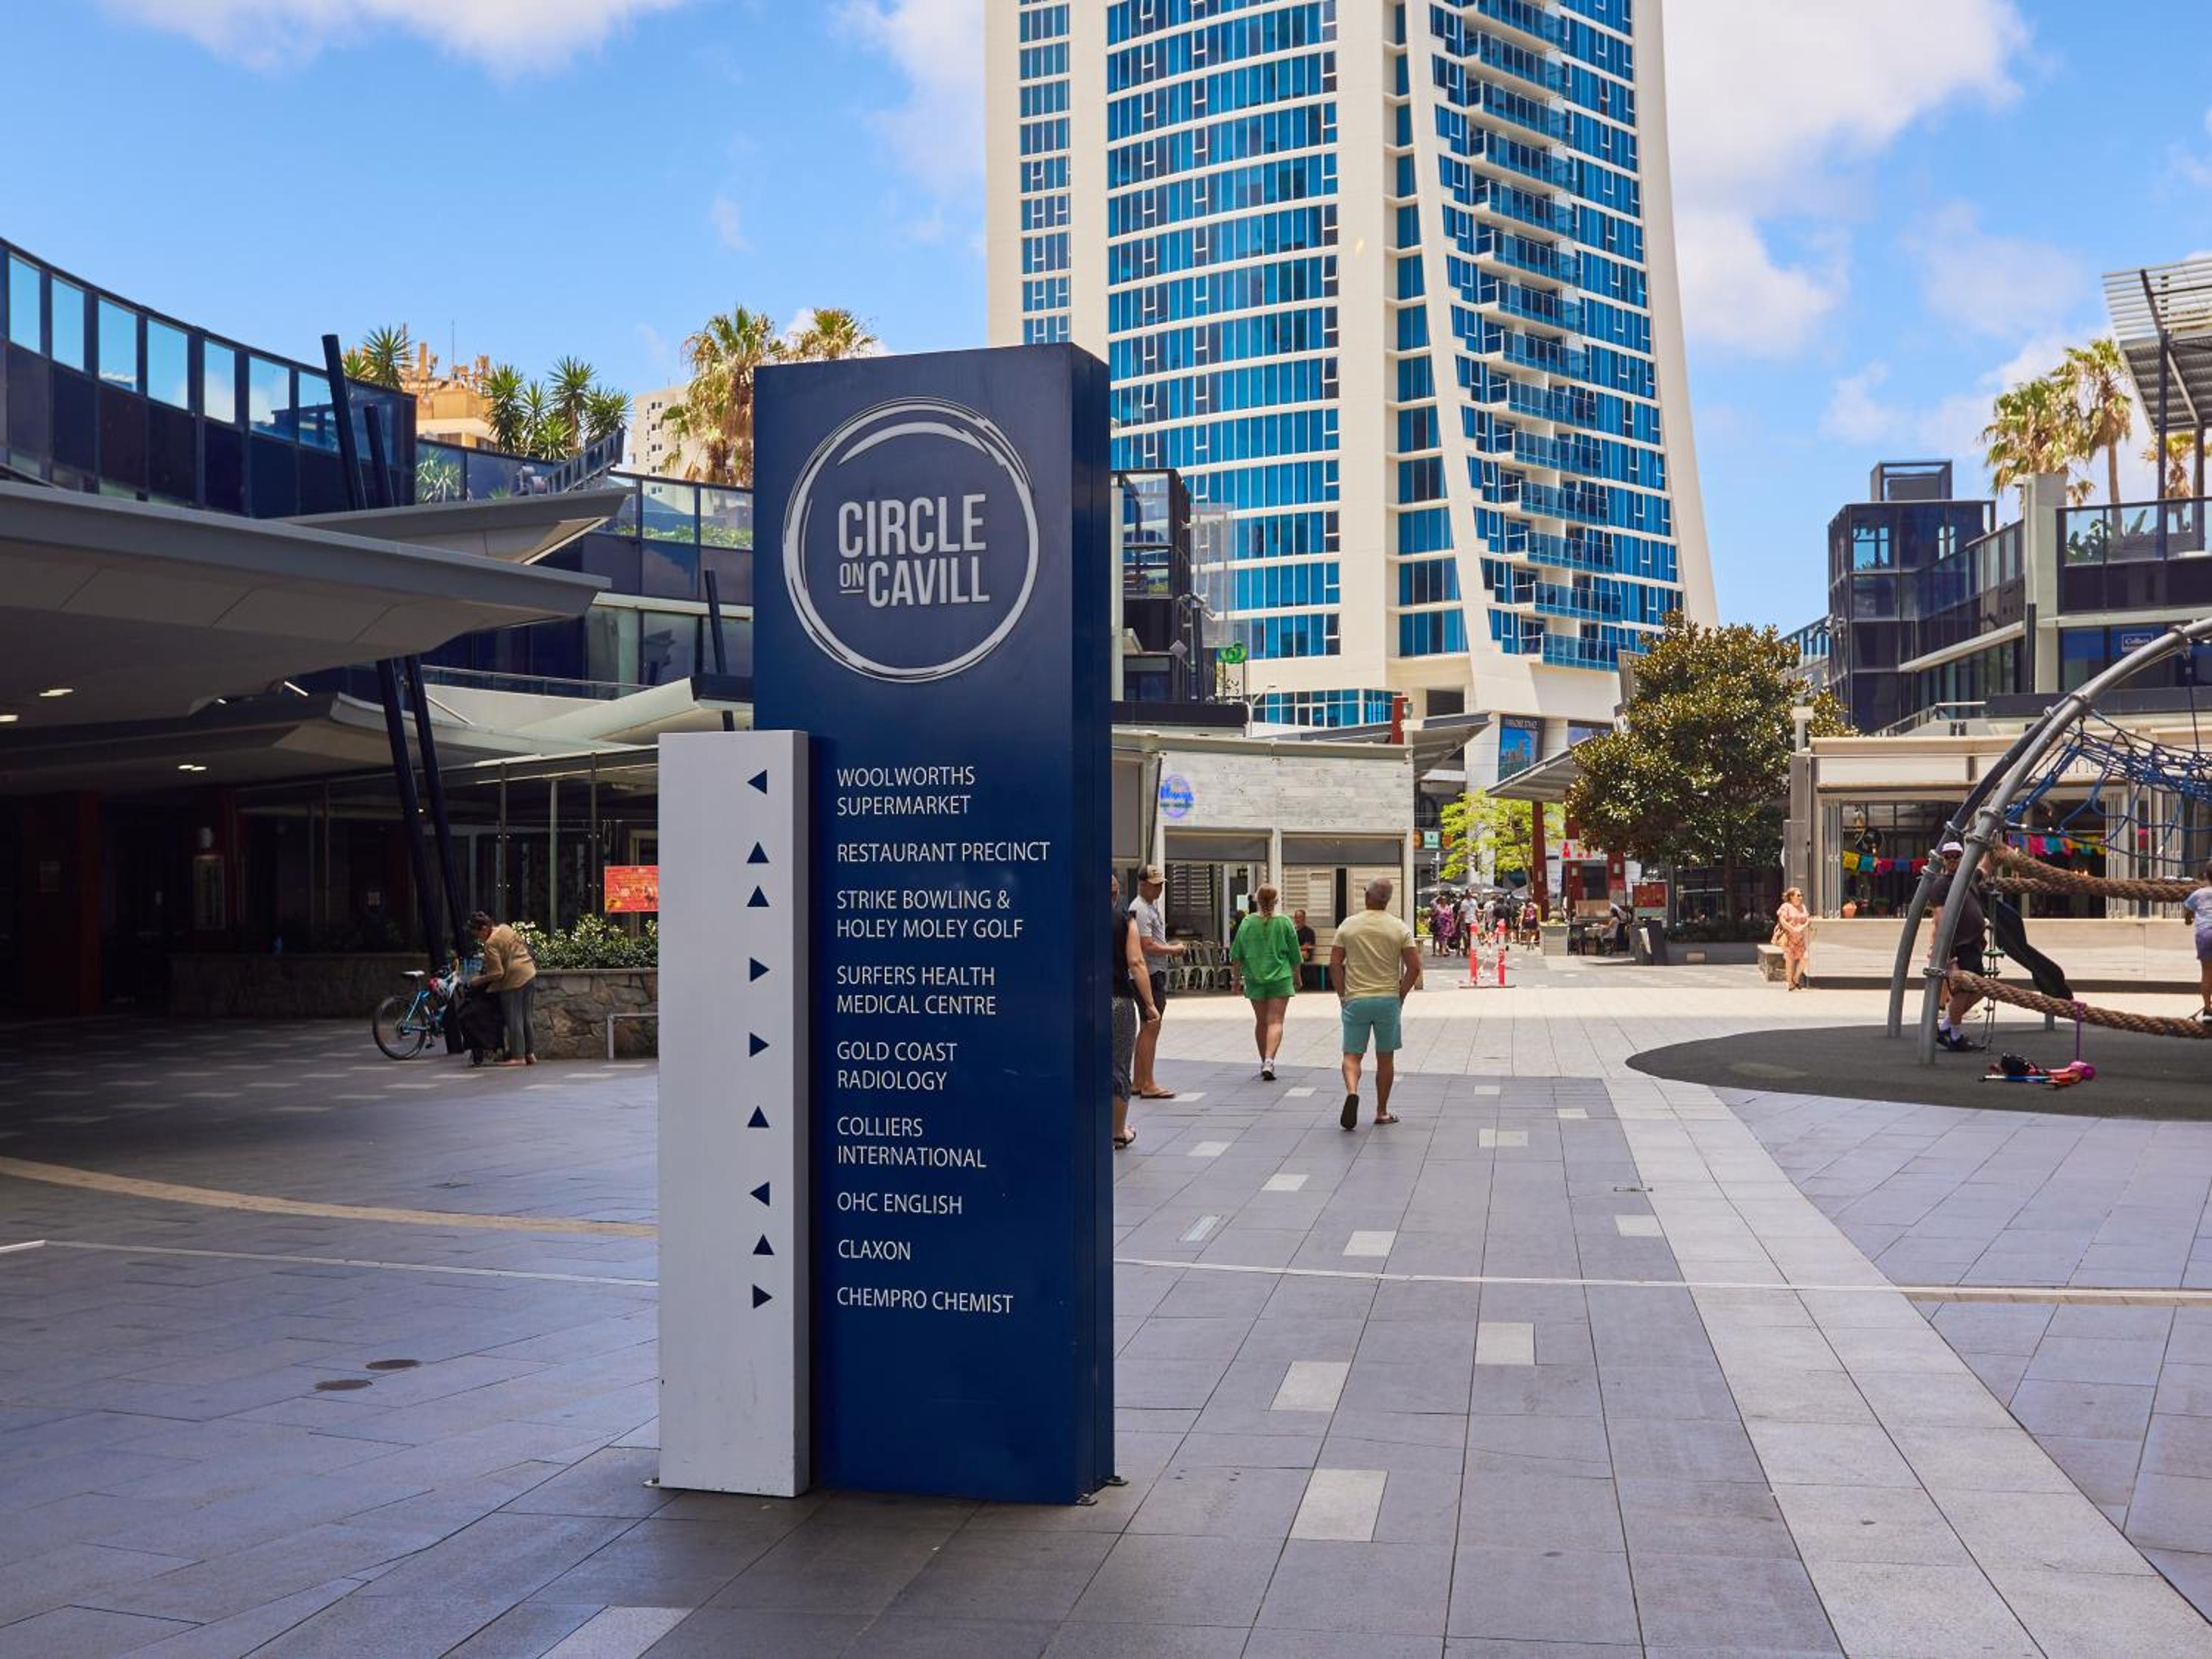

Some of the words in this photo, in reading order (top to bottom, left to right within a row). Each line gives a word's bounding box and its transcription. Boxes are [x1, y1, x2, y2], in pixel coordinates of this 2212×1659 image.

[838, 494, 987, 558] CIRCLE
[840, 563, 865, 588] ON
[869, 556, 990, 607] CAVILL
[837, 765, 975, 787] WOOLWORTHS
[837, 795, 971, 816] SUPERMARKET
[838, 843, 957, 862] RESTAURANT
[961, 841, 1051, 862] PRECINCT
[837, 890, 897, 909] STRIKE
[903, 890, 992, 909] BOWLING
[996, 890, 1010, 909] &
[837, 919, 897, 938] HOLEY
[903, 919, 968, 938] MOLEY
[973, 919, 1023, 939] GOLF
[837, 965, 916, 985] SURFERS
[922, 967, 995, 986] HEALTH
[837, 995, 920, 1014] MEDICAL
[925, 995, 996, 1015] CENTRE
[837, 1041, 890, 1061] GOLD
[894, 1042, 958, 1062] COAST
[838, 1070, 947, 1091] RADIOLOGY
[837, 1116, 923, 1137] COLLIERS
[838, 1145, 987, 1168] INTERNATIONAL
[837, 1192, 878, 1212] OHC
[884, 1193, 962, 1214] ENGLISH
[838, 1239, 911, 1260] CLAXON
[837, 1287, 927, 1309] CHEMPRO
[932, 1291, 1014, 1313] CHEMIST
